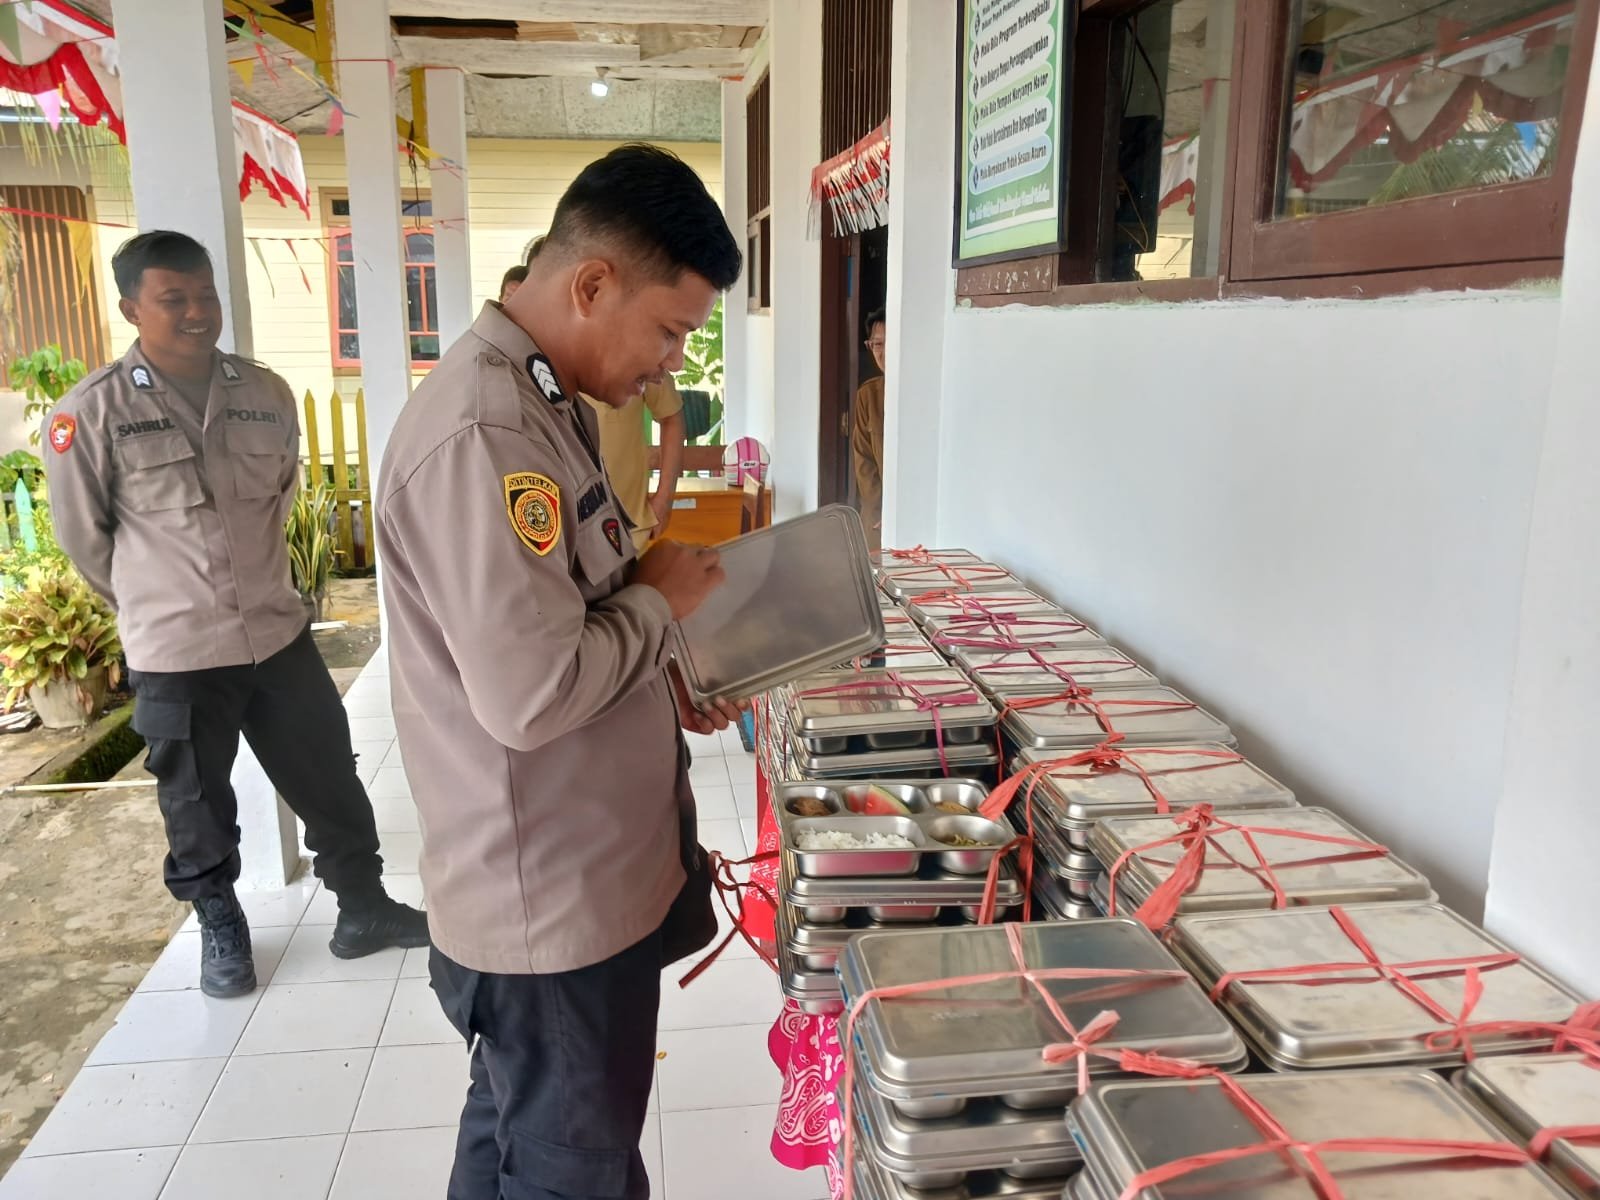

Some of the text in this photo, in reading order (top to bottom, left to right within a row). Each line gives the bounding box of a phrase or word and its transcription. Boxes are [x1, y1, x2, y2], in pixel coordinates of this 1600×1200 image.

[999, 22, 1017, 44] Program
[227, 408, 277, 424] POLRI
[117, 417, 176, 438] SAHRUL
